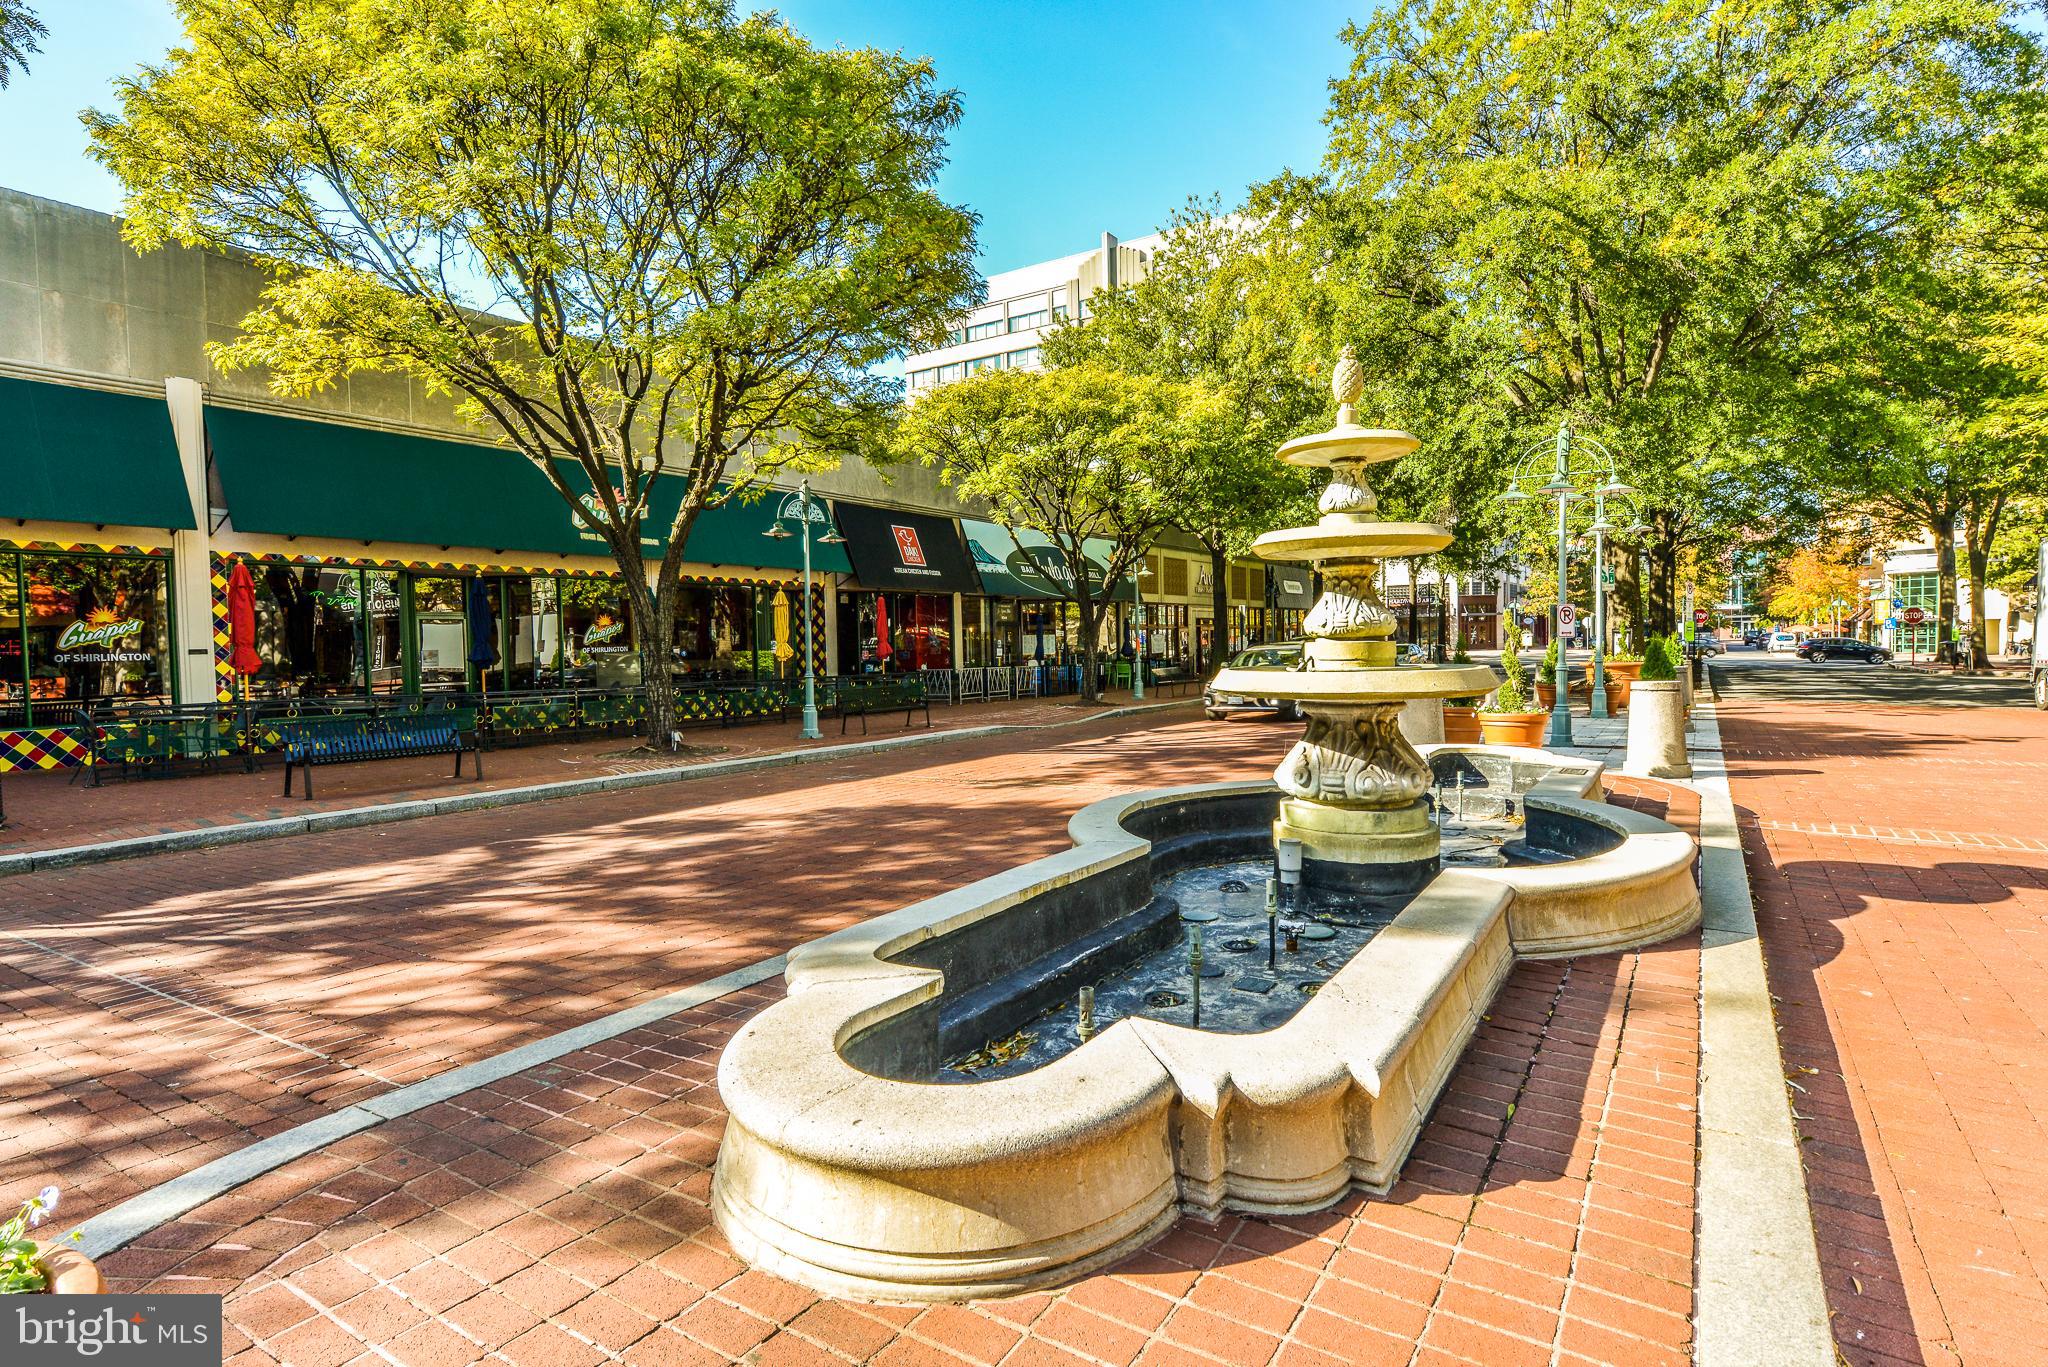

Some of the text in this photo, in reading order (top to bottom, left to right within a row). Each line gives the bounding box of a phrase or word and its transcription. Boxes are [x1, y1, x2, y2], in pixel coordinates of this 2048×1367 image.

[1020, 565, 1035, 574] BAR
[1904, 611, 1922, 619] STOP
[57, 618, 142, 651] Guapo's
[54, 653, 151, 662] OF SHIRLINGTON
